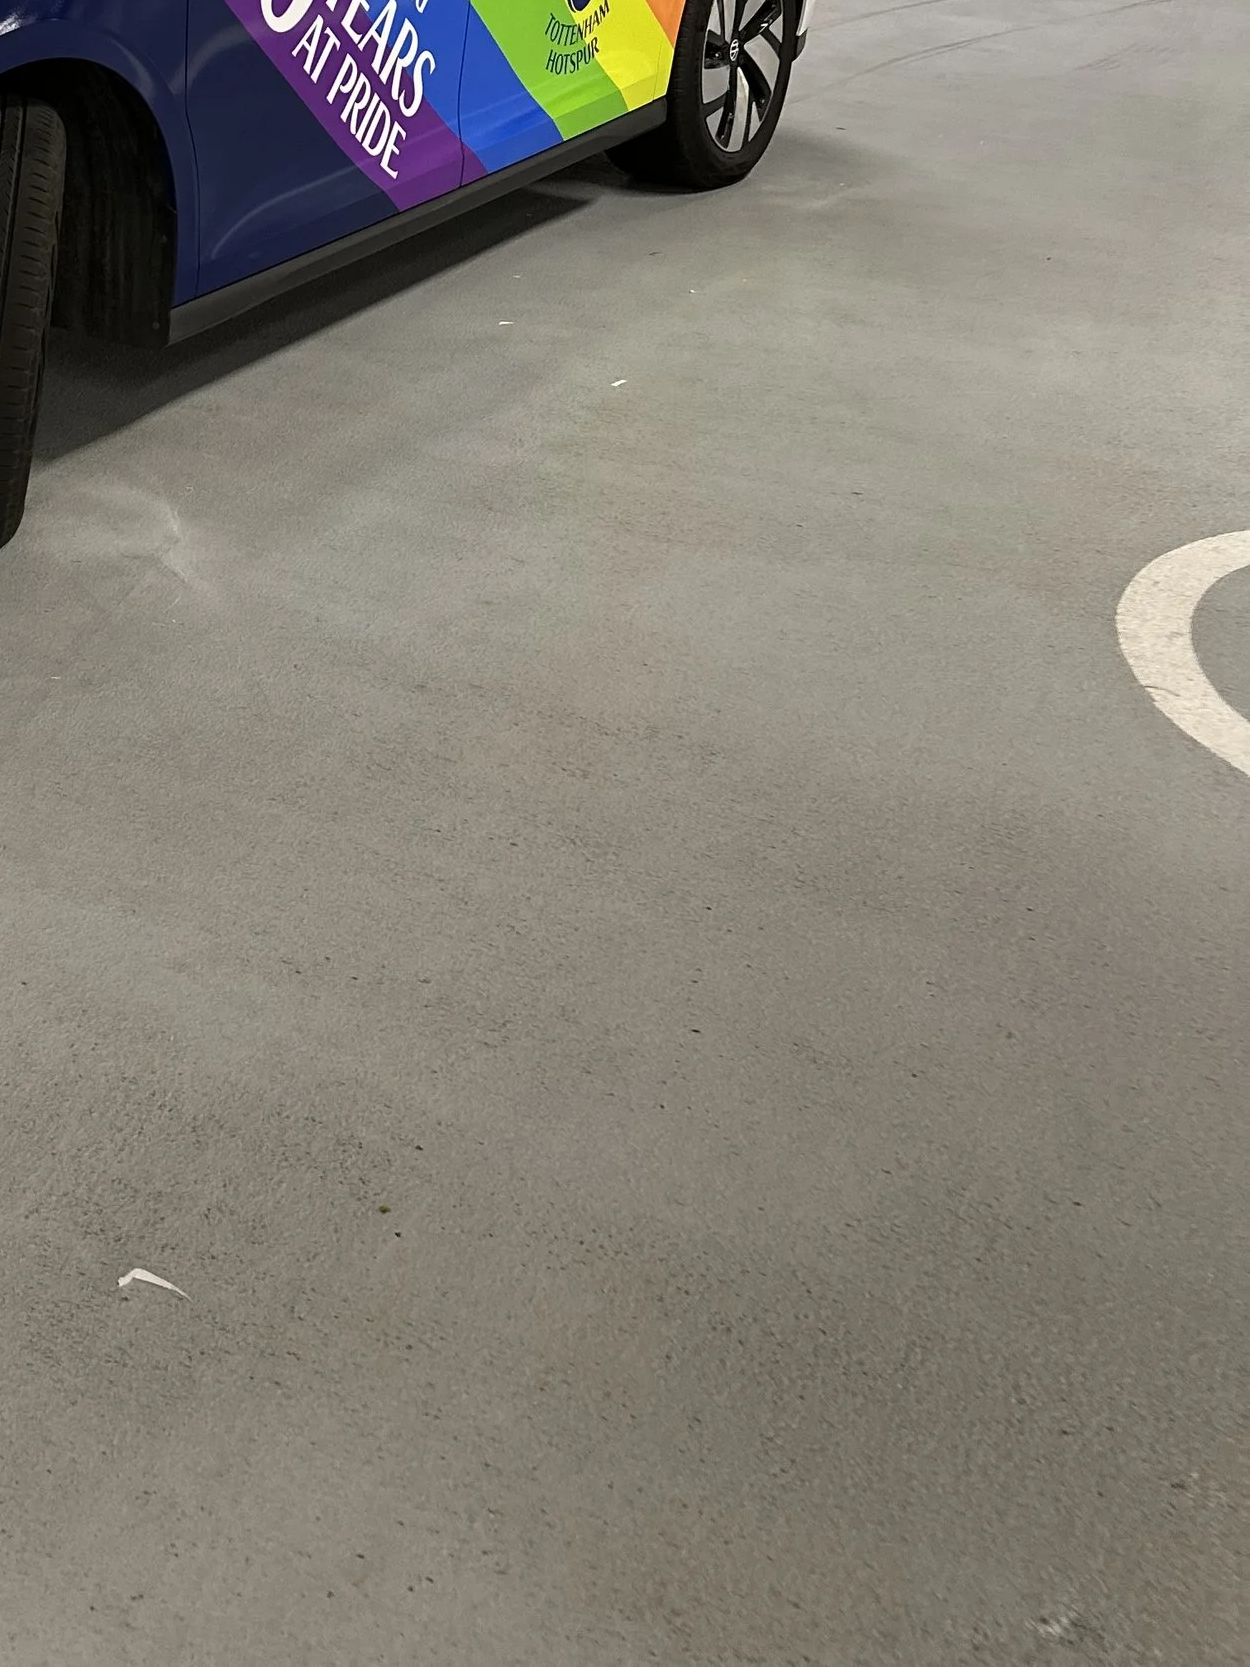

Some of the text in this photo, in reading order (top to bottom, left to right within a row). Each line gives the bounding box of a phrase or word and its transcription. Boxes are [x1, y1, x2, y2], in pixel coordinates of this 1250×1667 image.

[291, 14, 407, 180] AT PRIDE
[545, 37, 600, 76] HOTSPUR
